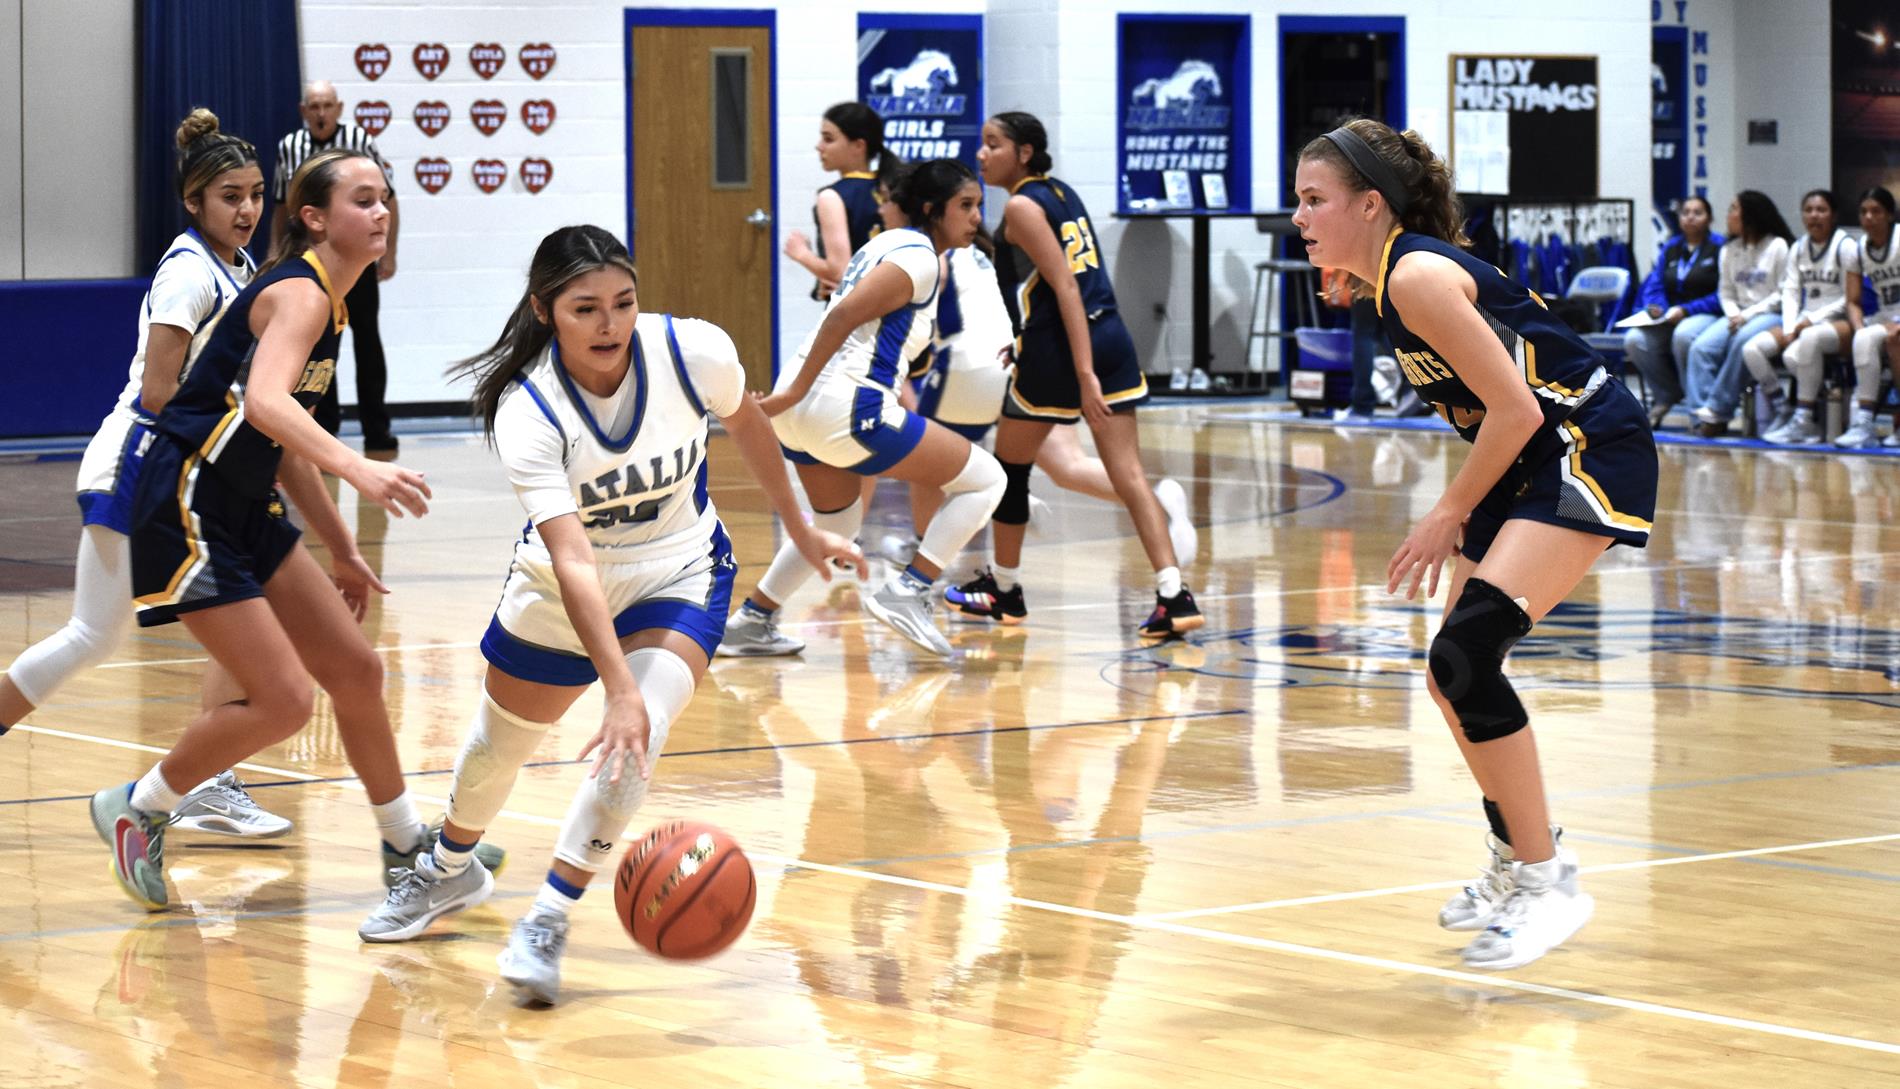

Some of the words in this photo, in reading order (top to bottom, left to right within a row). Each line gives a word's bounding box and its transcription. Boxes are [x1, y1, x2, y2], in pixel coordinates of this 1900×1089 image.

[1456, 59, 1534, 85] LADY
[1455, 82, 1598, 112] MUSTANGS
[884, 119, 945, 138] GIRLS
[884, 141, 961, 159] SITORS
[1125, 135, 1170, 150] HOME
[1173, 135, 1196, 150] OF
[1197, 135, 1229, 150] THE
[1126, 153, 1229, 171] MUSTANGS
